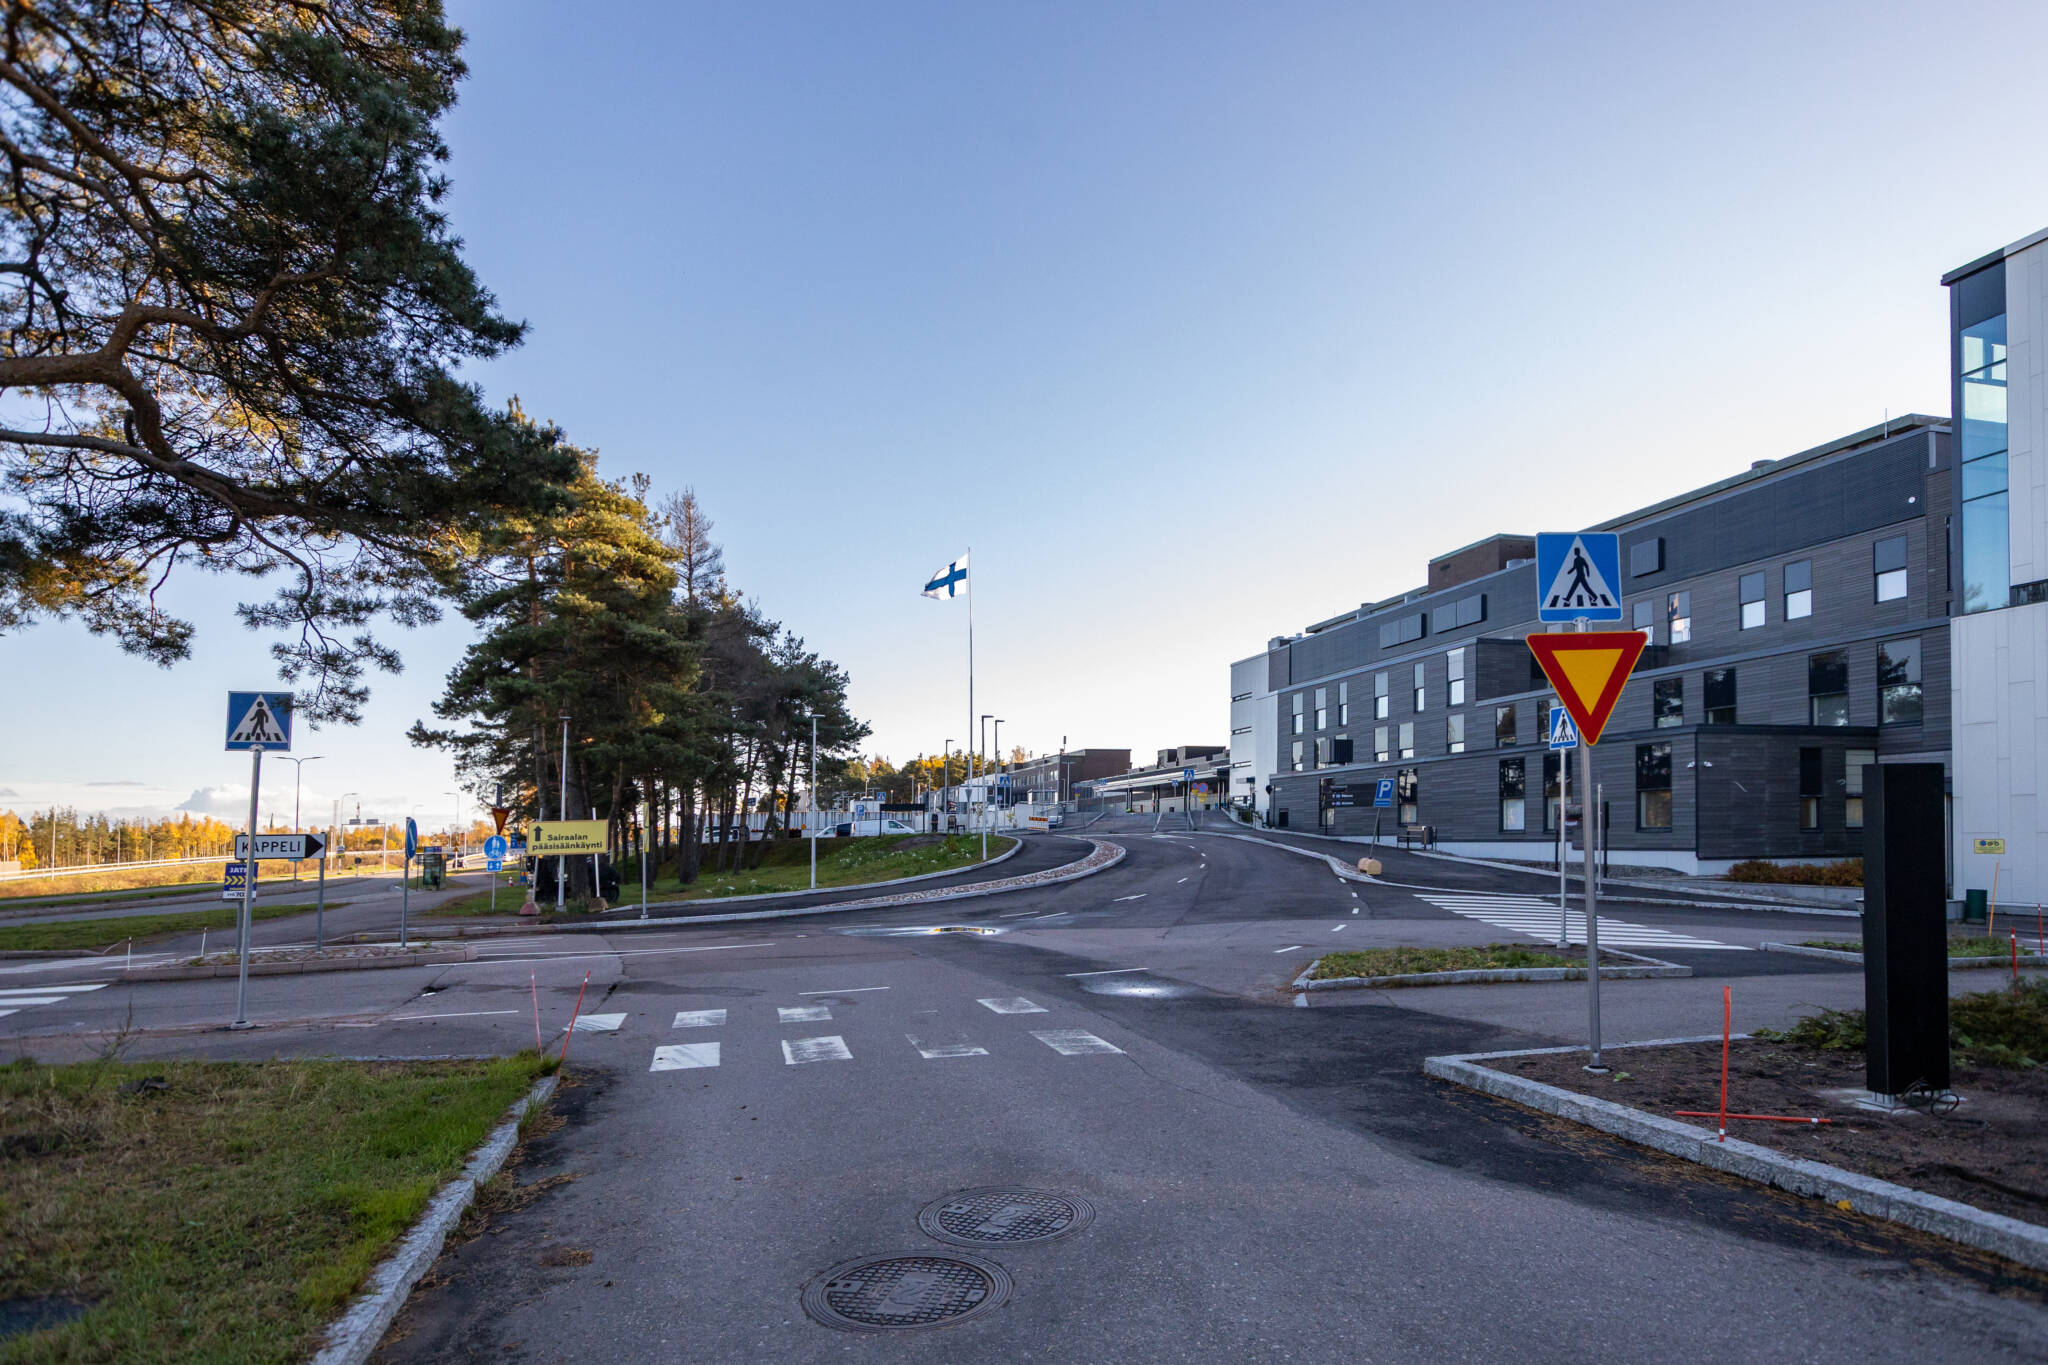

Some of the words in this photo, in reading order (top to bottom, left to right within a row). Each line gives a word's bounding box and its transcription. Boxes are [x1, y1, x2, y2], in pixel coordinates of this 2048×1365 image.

[1379, 781, 1391, 797] P
[547, 833, 588, 841] Sairaalan
[532, 841, 603, 851] pääsisäänkäynti
